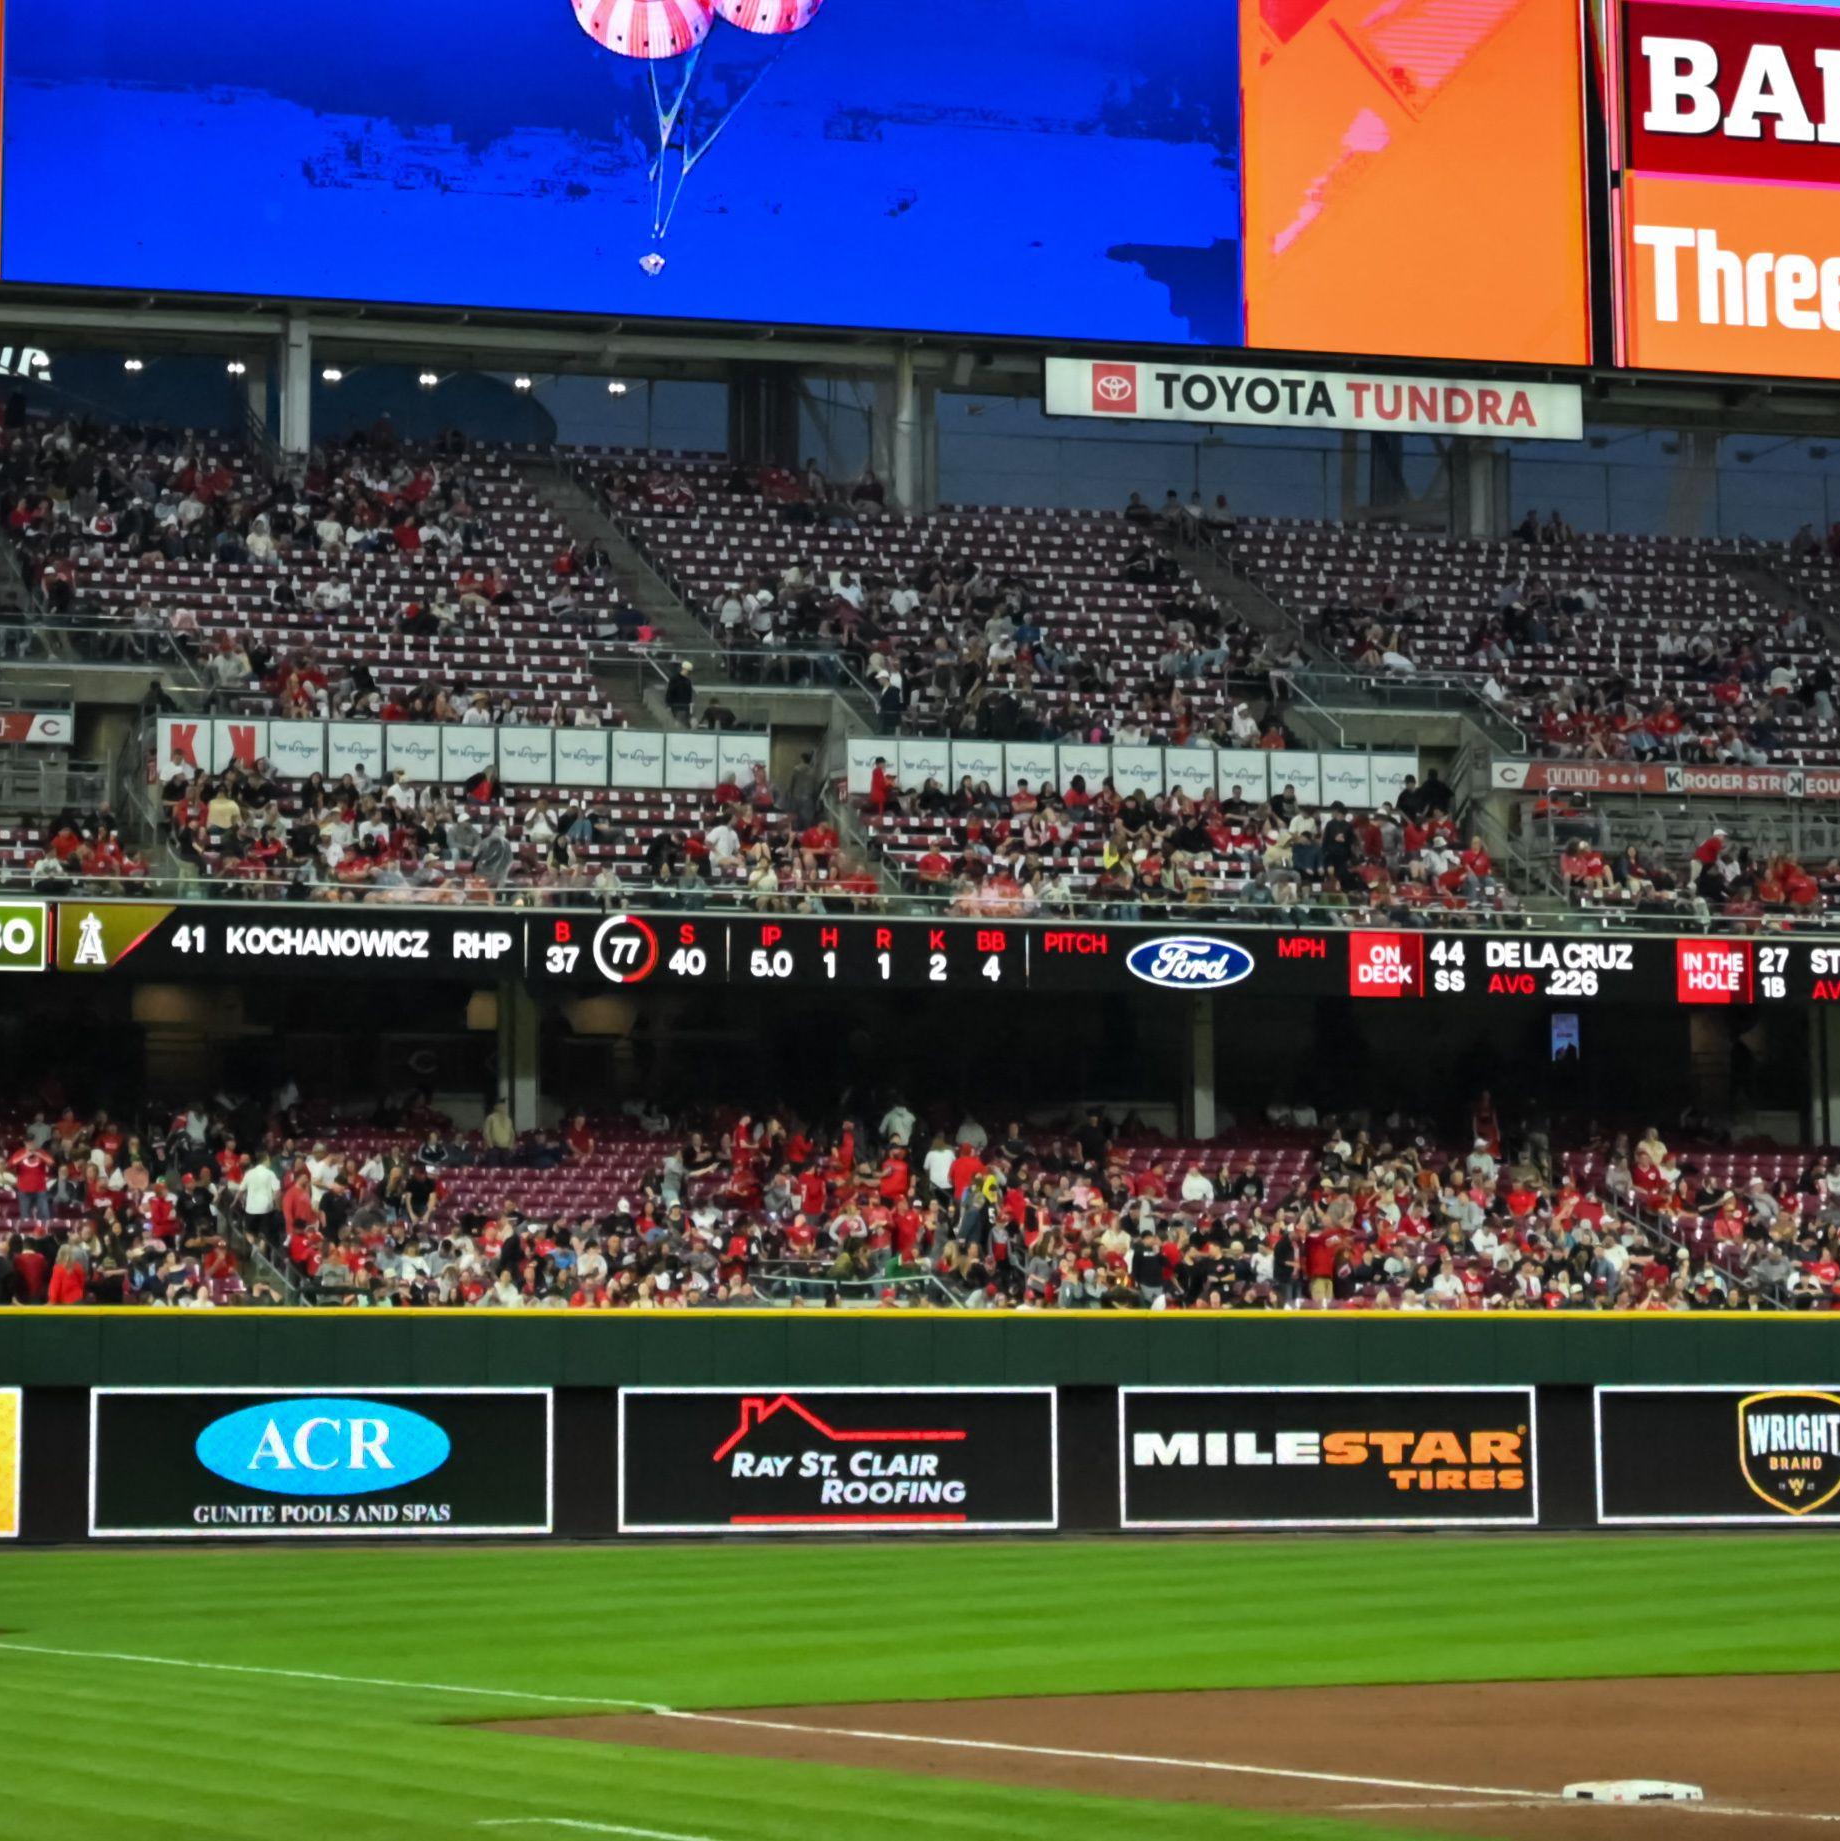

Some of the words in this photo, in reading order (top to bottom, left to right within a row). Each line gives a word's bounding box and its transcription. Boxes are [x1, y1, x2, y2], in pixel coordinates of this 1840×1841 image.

[1156, 372, 1336, 418] TOYOTA
[1346, 382, 1537, 427] TUNDRA
[170, 724, 197, 768] K
[1665, 766, 1742, 792] KROGER
[171, 925, 206, 954] 41
[226, 926, 429, 959] KOCHANOWICZ
[453, 931, 512, 960] RHP
[554, 921, 571, 943] B
[680, 924, 695, 946] S
[761, 924, 781, 947] IP
[822, 927, 838, 948] H
[877, 928, 892, 950] R
[929, 929, 946, 951] K
[977, 930, 1006, 952] BB
[1043, 932, 1107, 955] PITCH
[546, 946, 580, 974] 37
[609, 936, 642, 965] 77
[1278, 937, 1326, 960] MPH
[1369, 945, 1401, 964] ON
[1430, 941, 1465, 965] 44
[1486, 941, 1523, 967] DE
[1524, 942, 1566, 969] LA
[1567, 943, 1634, 971] CRUZ
[1759, 948, 1789, 973] 27
[668, 948, 706, 976] 40
[750, 950, 794, 979] 5.0
[824, 952, 837, 979] 1
[878, 953, 890, 980] 1
[929, 955, 947, 981] 2
[982, 956, 1001, 982] 4
[1151, 942, 1228, 982] Ford
[1358, 964, 1412, 985] DECK
[1683, 952, 1701, 969] IN
[1707, 953, 1744, 972] THE
[1434, 970, 1465, 993] SS
[1488, 974, 1535, 994] AVG
[1545, 972, 1598, 996] .226
[1688, 972, 1740, 991] HOLE
[1762, 977, 1786, 998] 1B
[246, 1417, 395, 1471] ACR
[1133, 1431, 1522, 1466] MILESTAR
[731, 1452, 792, 1478] RAY
[798, 1452, 838, 1477] ST.
[849, 1451, 939, 1477] CLAIR
[1769, 1456, 1823, 1470] BRAND
[821, 1480, 966, 1505] ROOFING
[1389, 1469, 1525, 1490] TIRES
[193, 1505, 275, 1523] GUNITE
[281, 1504, 350, 1523] POOLS
[354, 1504, 398, 1522] AND
[402, 1504, 451, 1522] SPAS
